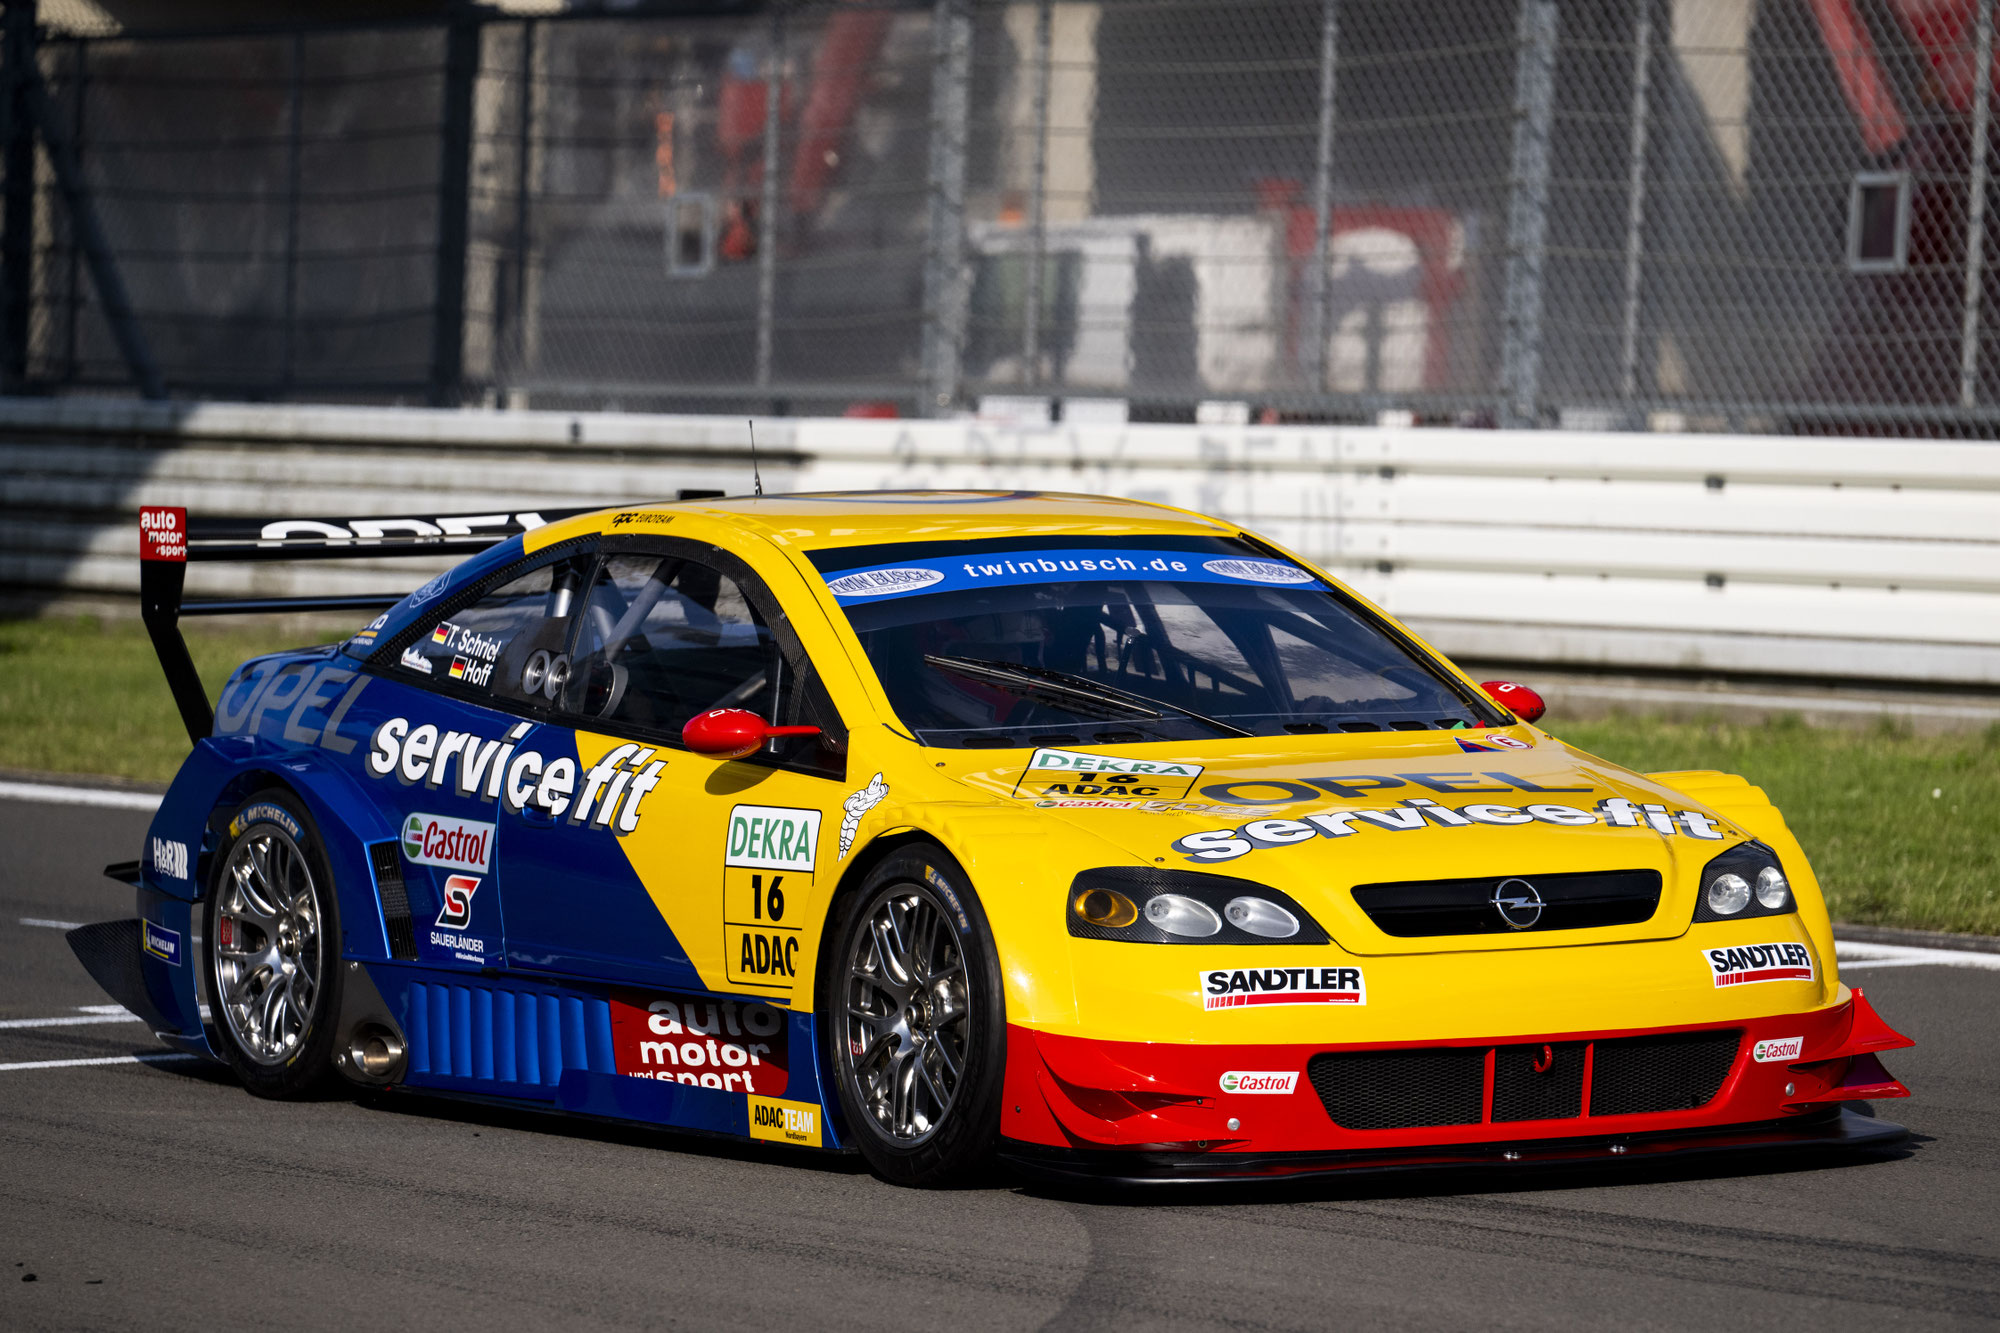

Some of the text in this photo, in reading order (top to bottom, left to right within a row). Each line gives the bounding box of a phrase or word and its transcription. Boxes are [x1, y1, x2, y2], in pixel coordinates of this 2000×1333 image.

[141, 510, 176, 530] auto
[148, 530, 182, 544] motor
[160, 545, 187, 557] sport
[963, 557, 1188, 578] twinbusch.de
[829, 569, 935, 593] TWIN BUSCH
[864, 583, 918, 595] GERMANY
[447, 624, 460, 648] T.
[463, 659, 493, 687] Hoff
[218, 661, 373, 755] OPEL
[1038, 753, 1190, 776] DEKRA
[1041, 784, 1160, 797] ADAC
[1078, 773, 1140, 784] 16
[1199, 771, 1595, 807] OPEL
[1057, 800, 1132, 809] Castrol
[247, 805, 300, 838] MICHELIN
[423, 821, 489, 866] Castrol
[730, 816, 811, 862] DEKRA
[153, 836, 174, 876] H&R
[752, 874, 785, 922] 16
[150, 934, 175, 954] MICHELIN
[430, 931, 484, 953] SAUERLÄNDER
[741, 933, 799, 978] ADAC
[1710, 944, 1811, 973] SANDTLER
[1207, 968, 1361, 995] SANDTLER
[648, 1000, 782, 1036] auto
[640, 1039, 771, 1067] motor
[1766, 1041, 1800, 1058] Castrol
[1239, 1074, 1292, 1090] Castrol
